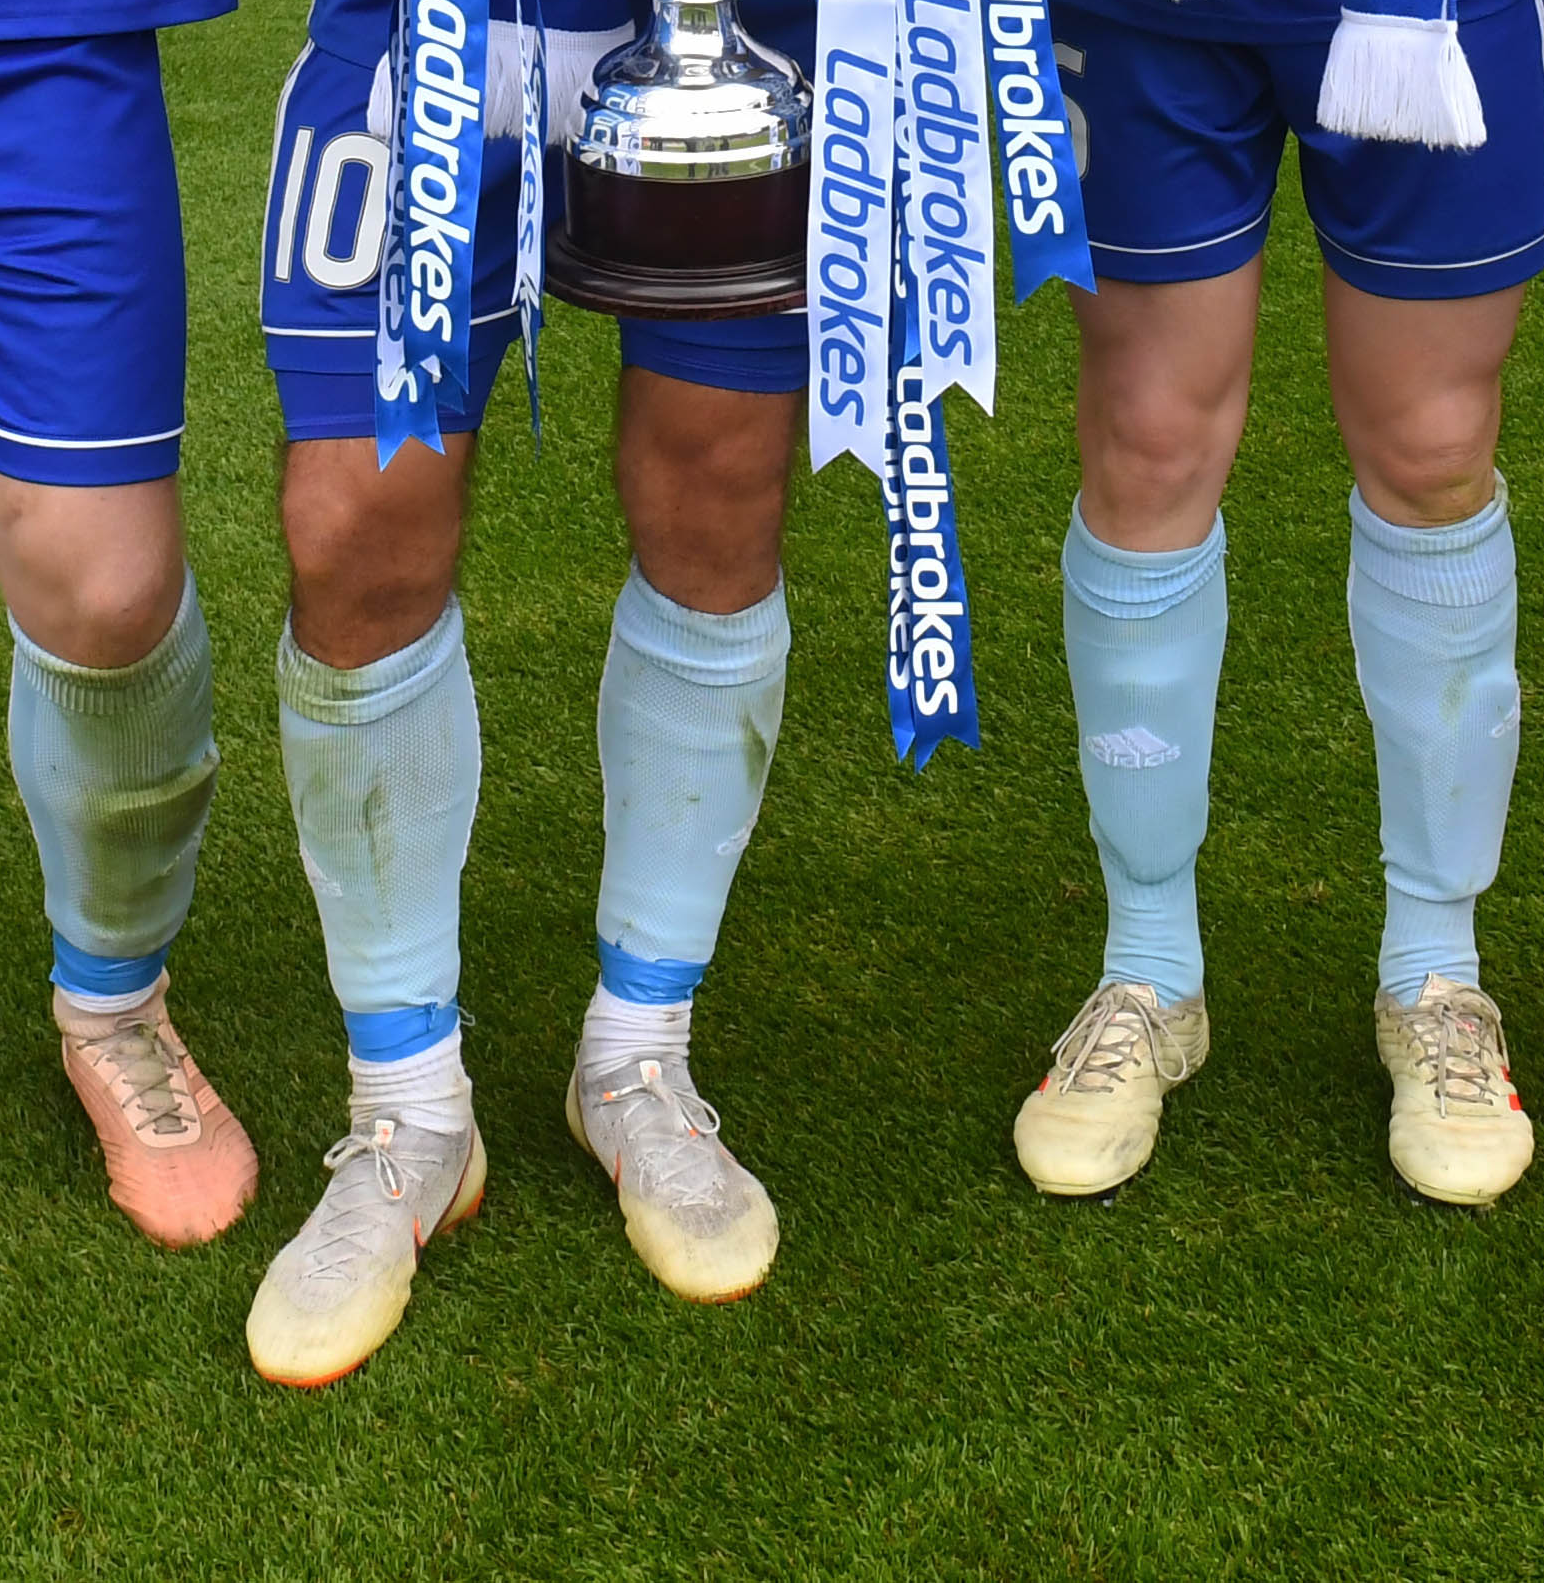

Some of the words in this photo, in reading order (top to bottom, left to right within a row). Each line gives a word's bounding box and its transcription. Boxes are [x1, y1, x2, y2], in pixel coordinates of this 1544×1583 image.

[273, 124, 392, 291] 10
[819, 48, 889, 427] Ladbrokes
[897, 364, 965, 717] Ladbrokes
